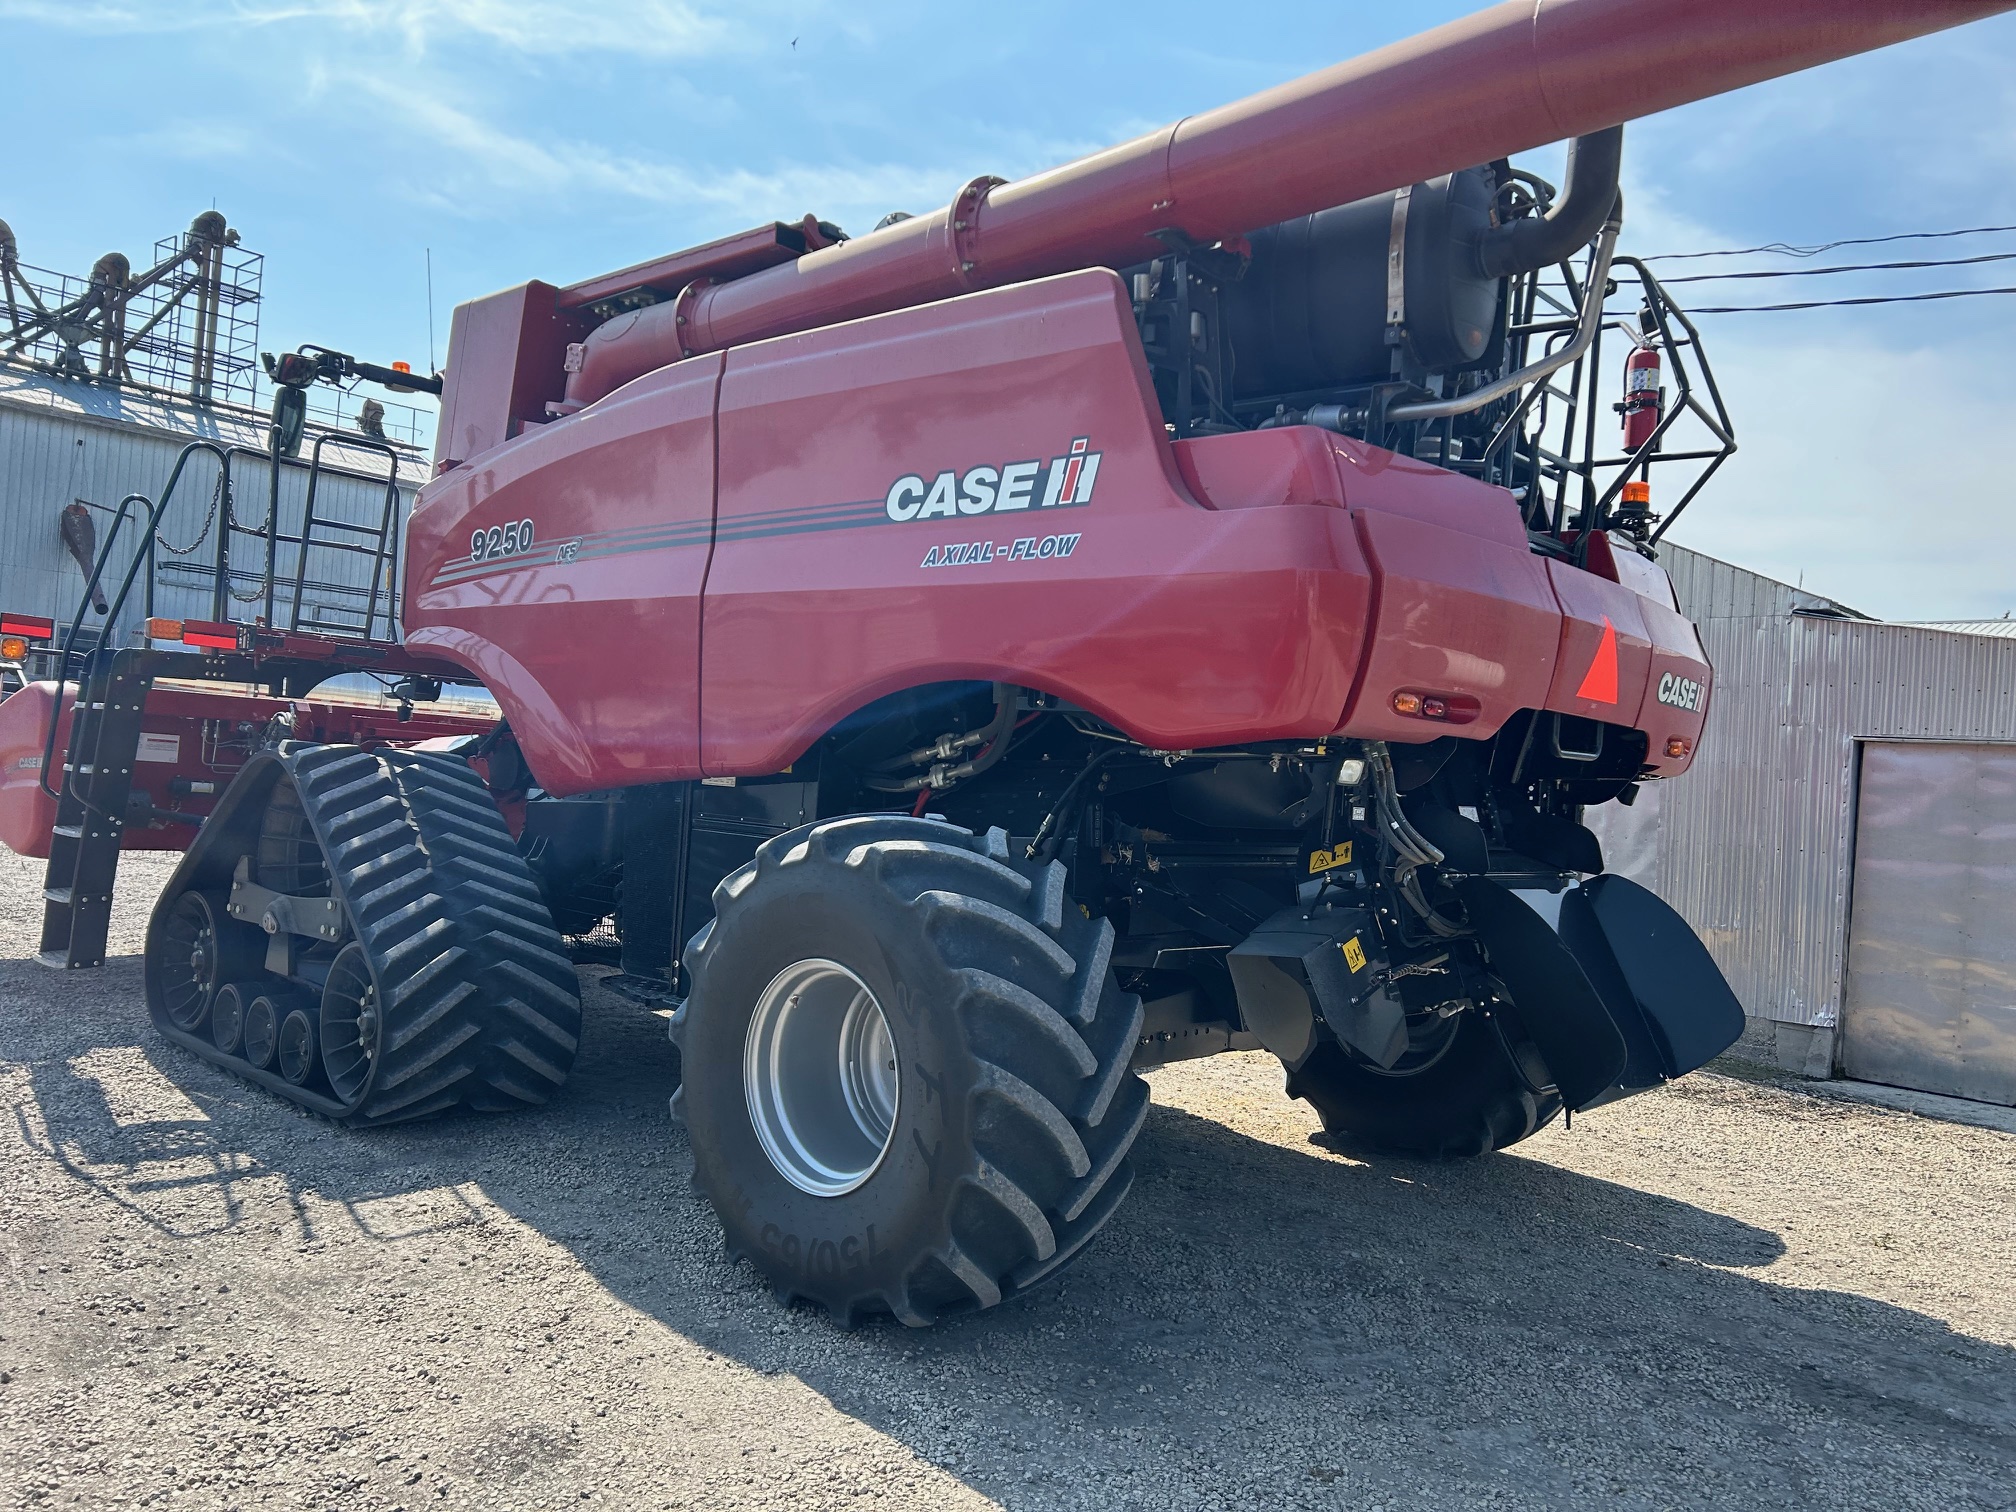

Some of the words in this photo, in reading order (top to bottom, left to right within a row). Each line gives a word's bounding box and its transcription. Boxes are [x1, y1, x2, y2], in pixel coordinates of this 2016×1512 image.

[886, 461, 1040, 522] CASE
[471, 518, 534, 563] 9250
[1658, 672, 1697, 710] CASE
[18, 757, 37, 769] CASE
